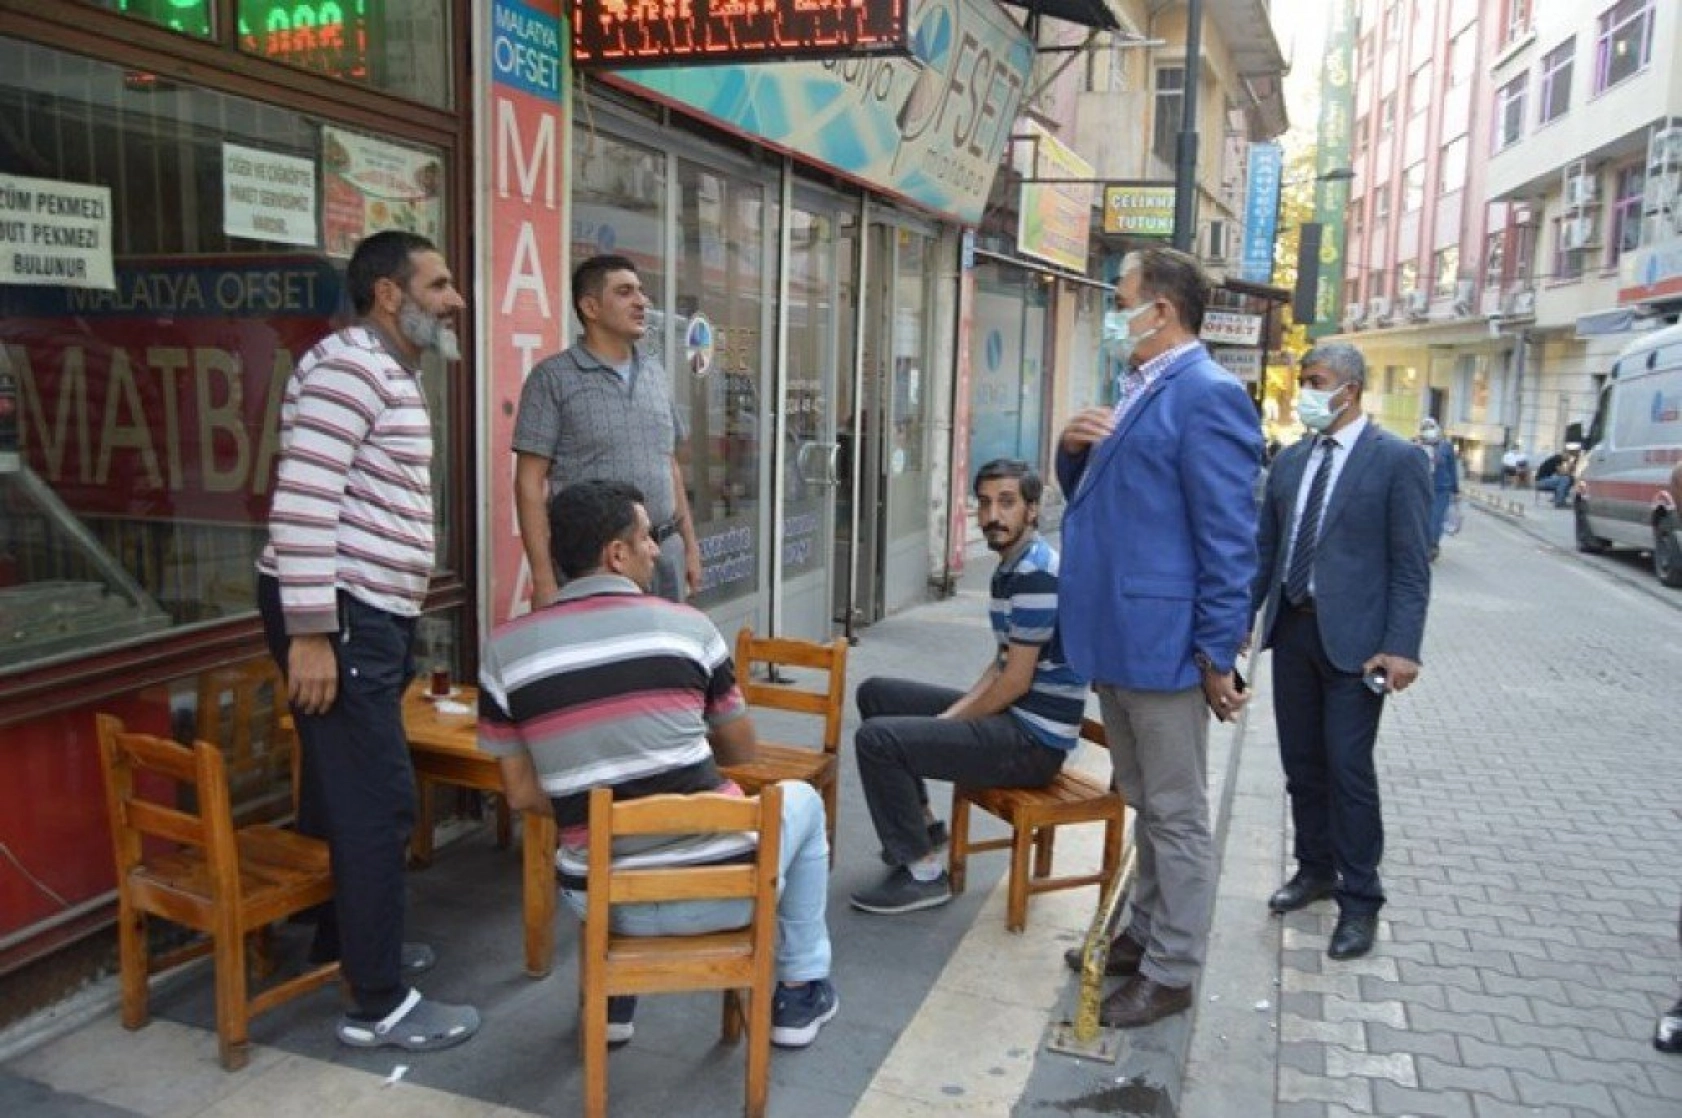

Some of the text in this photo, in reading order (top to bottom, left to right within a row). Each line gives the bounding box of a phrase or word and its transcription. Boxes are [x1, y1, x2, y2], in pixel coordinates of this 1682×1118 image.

[495, 3, 558, 52] MALATYA
[495, 35, 558, 92] OFSET
[14, 253, 87, 279] BULUNUR
[215, 272, 319, 310] OFSET
